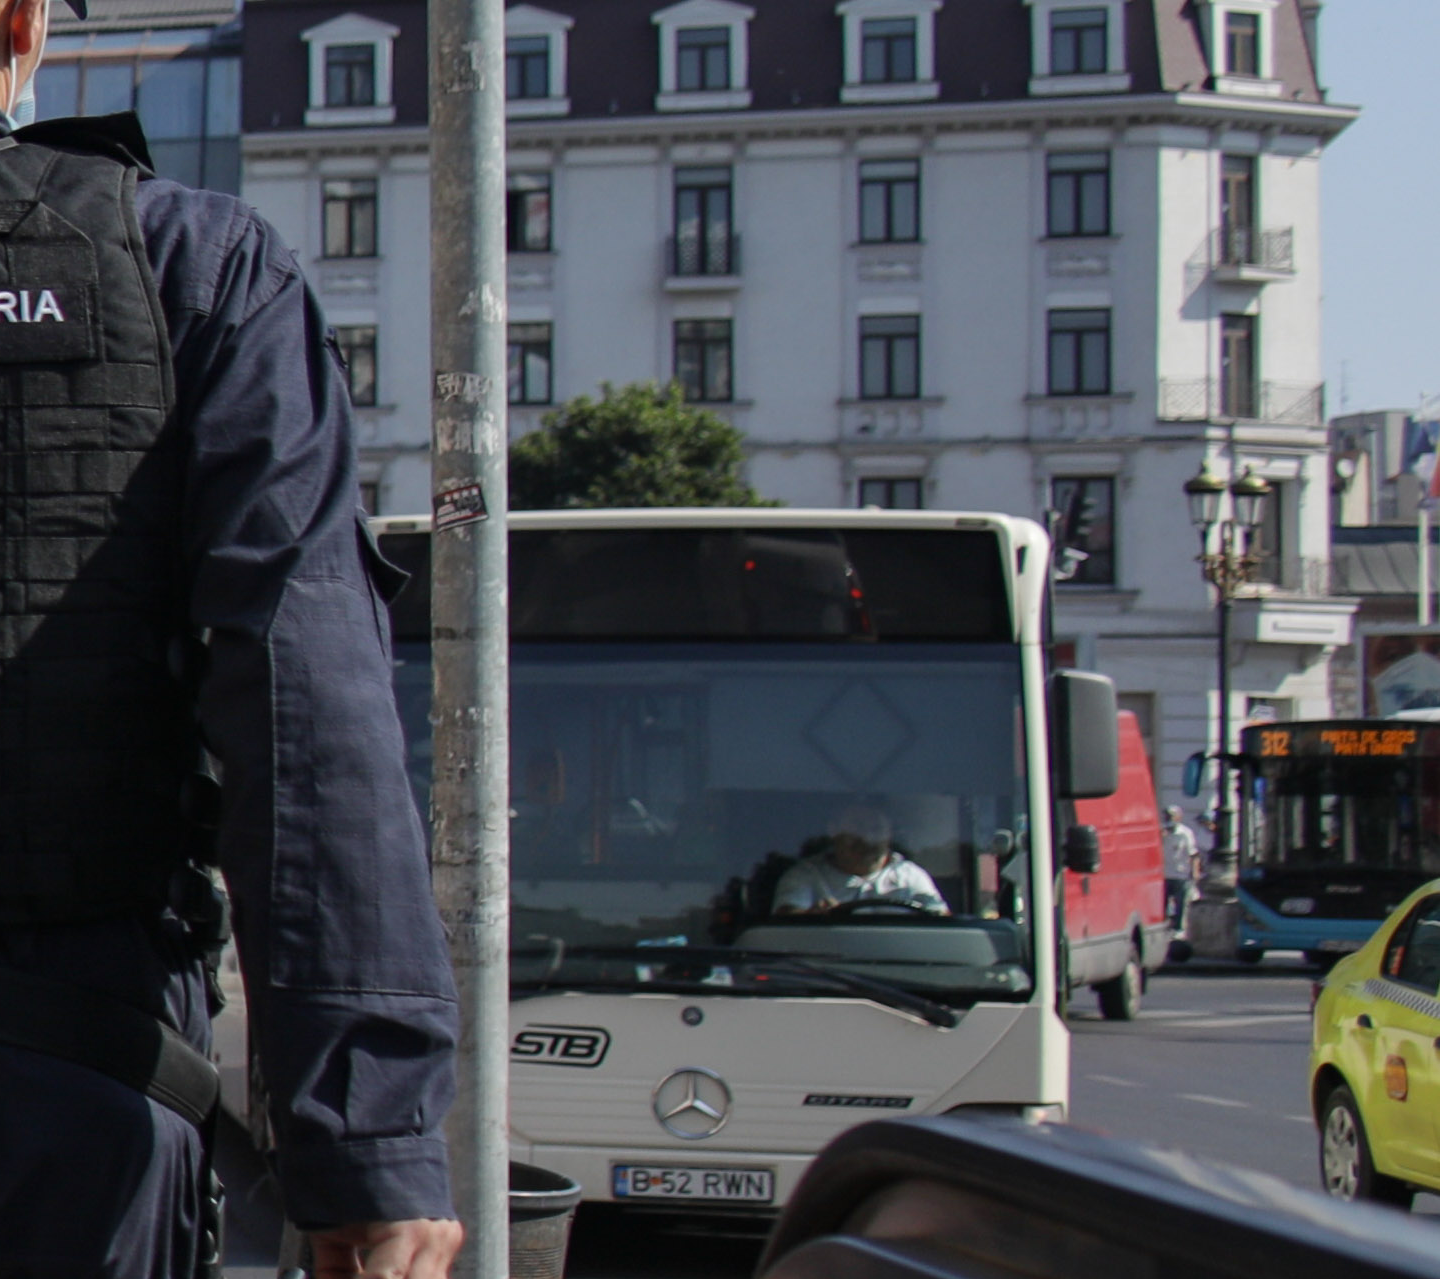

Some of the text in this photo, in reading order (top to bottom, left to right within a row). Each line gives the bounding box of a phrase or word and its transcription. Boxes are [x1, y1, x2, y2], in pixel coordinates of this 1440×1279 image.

[1260, 731, 1290, 757] 312
[510, 1030, 600, 1060] STB
[631, 1170, 767, 1198] B 52 RWN
